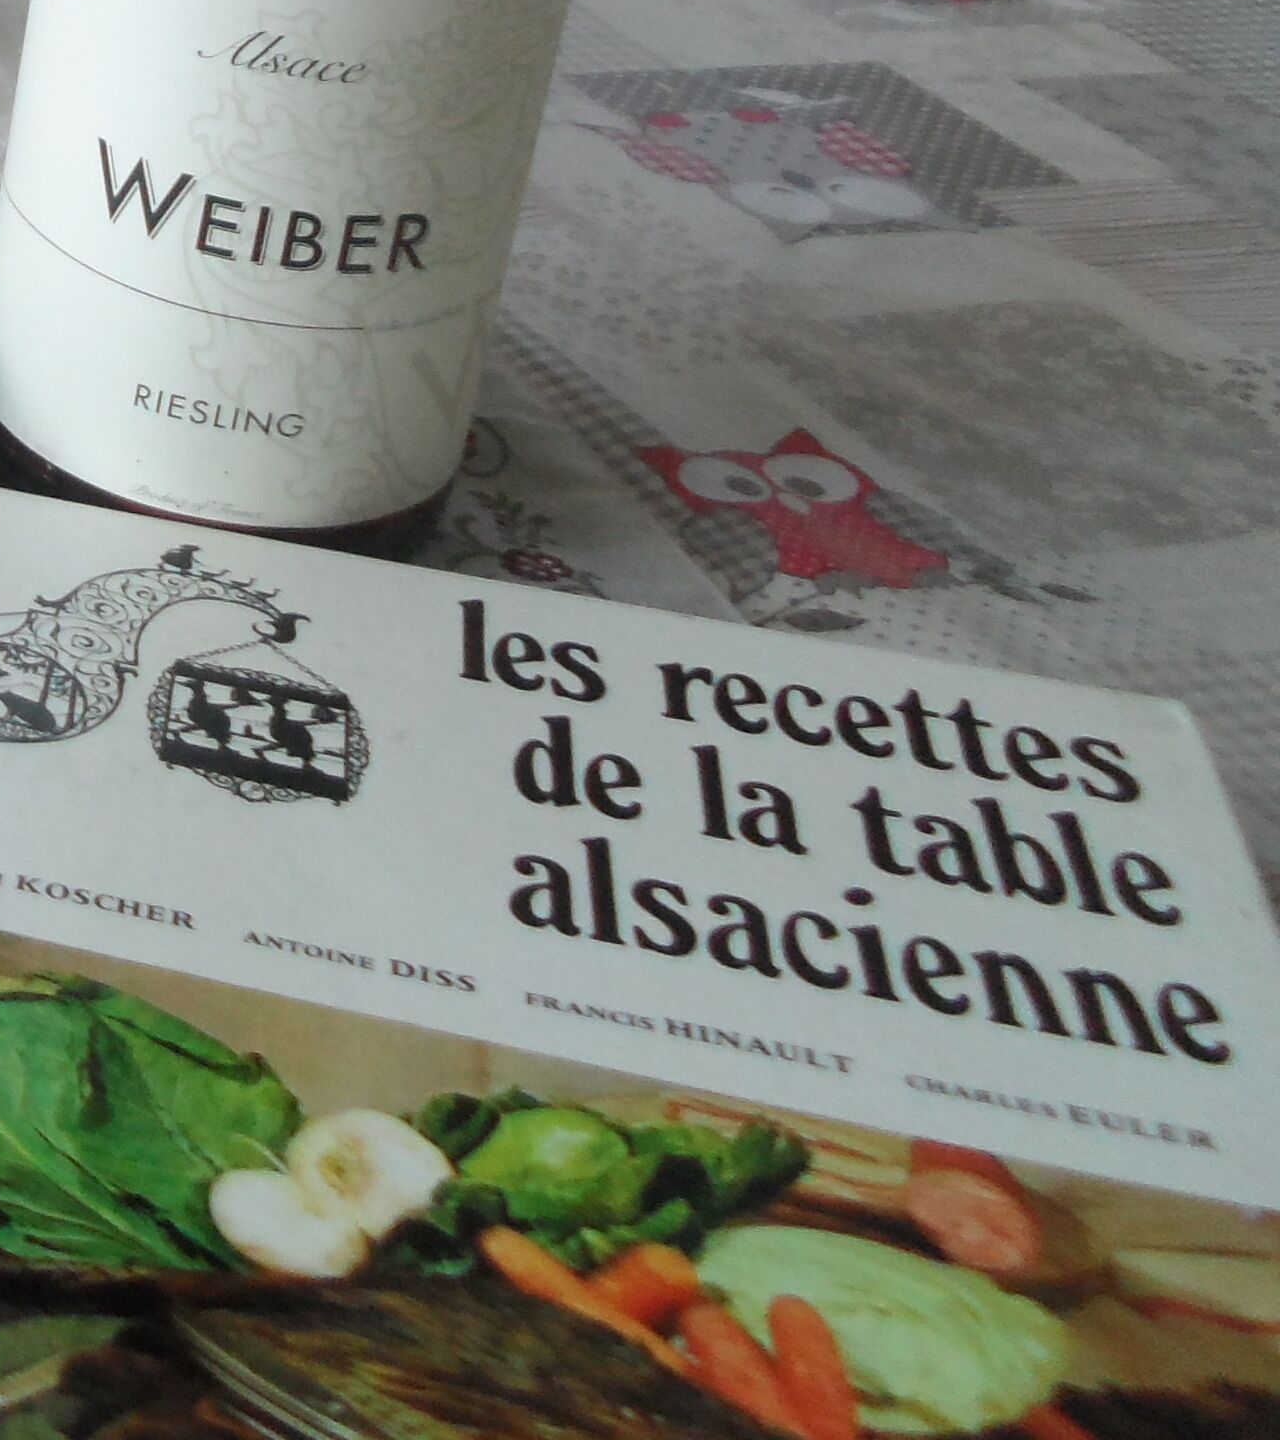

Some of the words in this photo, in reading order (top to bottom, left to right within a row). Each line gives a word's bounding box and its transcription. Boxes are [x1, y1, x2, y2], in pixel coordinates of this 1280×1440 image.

[197, 30, 367, 85] Alsace
[98, 136, 431, 275] WEIBER
[134, 383, 305, 438] RIESLING
[459, 598, 607, 703] les
[656, 662, 1142, 803] recettes
[513, 716, 643, 820] de
[692, 745, 809, 856] la
[851, 786, 1183, 927] table
[14, 874, 197, 931] KOSCHER
[243, 930, 375, 972] ANTOINE
[389, 957, 478, 993] DISS
[508, 836, 1231, 1066] alsacienne
[524, 991, 656, 1032] FRANCIS
[663, 1017, 855, 1075] HINAULT
[903, 1072, 1059, 1120] CHARLES
[1060, 1103, 1219, 1151] EULER
